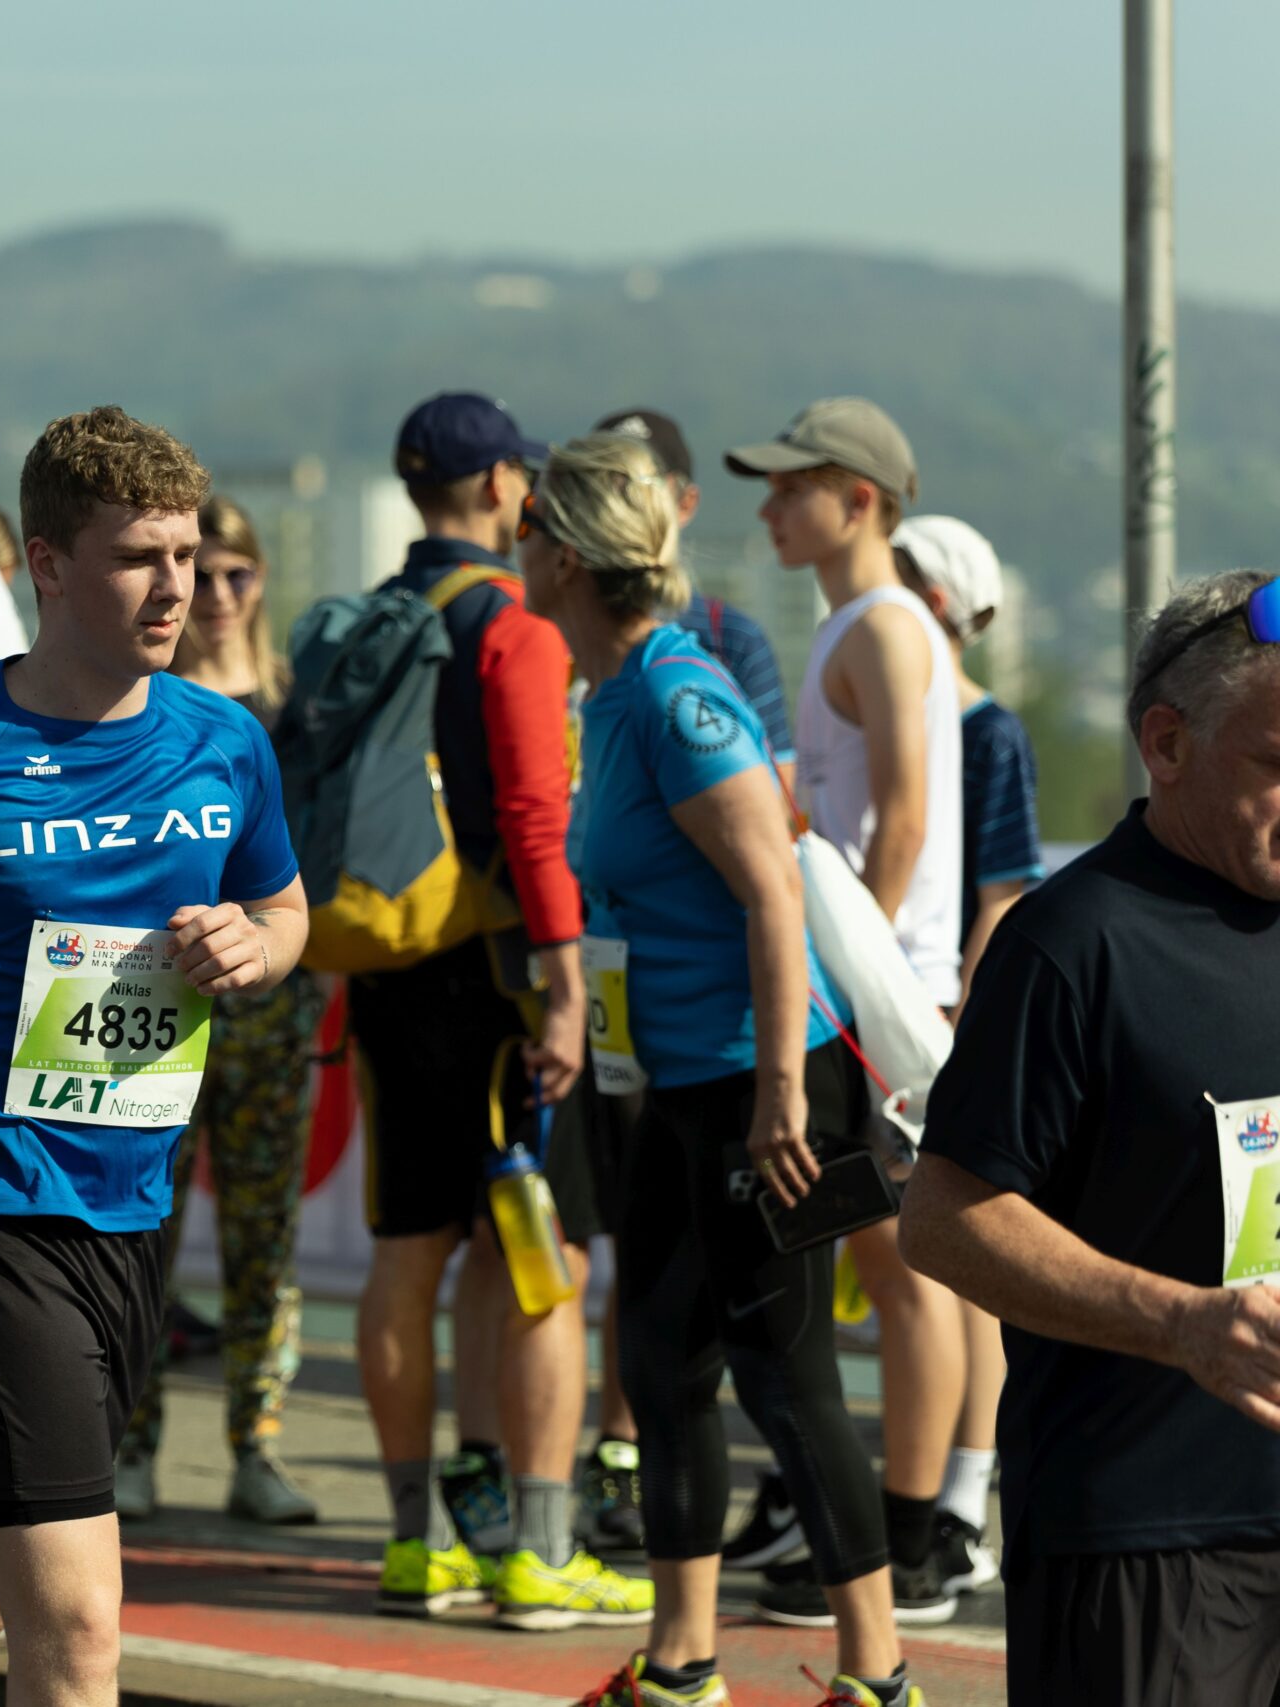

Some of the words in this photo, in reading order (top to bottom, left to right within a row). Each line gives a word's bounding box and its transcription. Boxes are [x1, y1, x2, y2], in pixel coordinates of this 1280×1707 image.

[23, 764, 61, 776] erima
[153, 804, 231, 843] AG
[94, 939, 109, 950] 22.
[110, 940, 154, 953] Oberbank
[92, 951, 114, 959] LINZ
[120, 953, 154, 962] DONAU
[91, 960, 152, 971] MARATHON
[110, 982, 152, 998] Niklas
[63, 1002, 178, 1052] 4835
[29, 1060, 51, 1068] LAT
[56, 1061, 115, 1072] NITROGEN
[28, 1073, 110, 1115] LAT
[109, 1098, 180, 1122] Nitrogen
